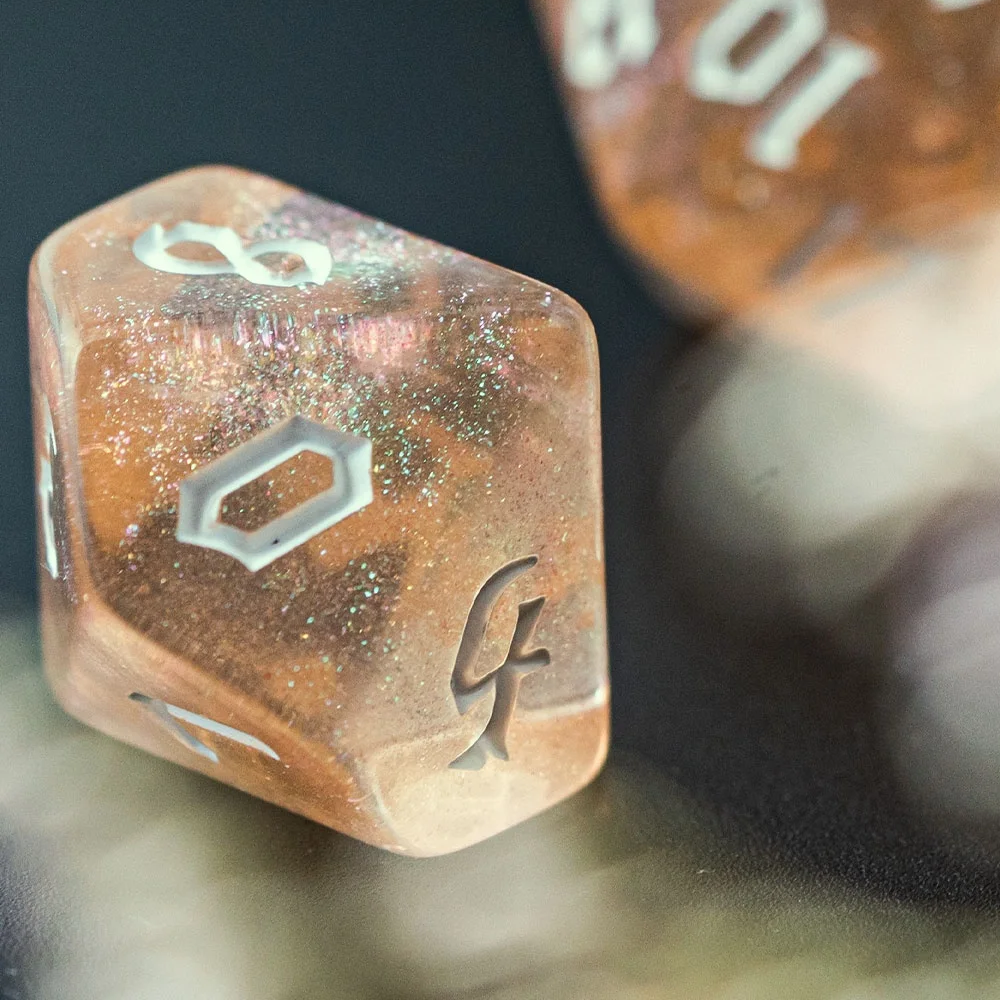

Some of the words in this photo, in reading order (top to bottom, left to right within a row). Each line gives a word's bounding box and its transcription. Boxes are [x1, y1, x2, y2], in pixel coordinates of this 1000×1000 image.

[132, 221, 334, 288] 8
[176, 414, 374, 572] 0
[449, 556, 552, 770] 4
